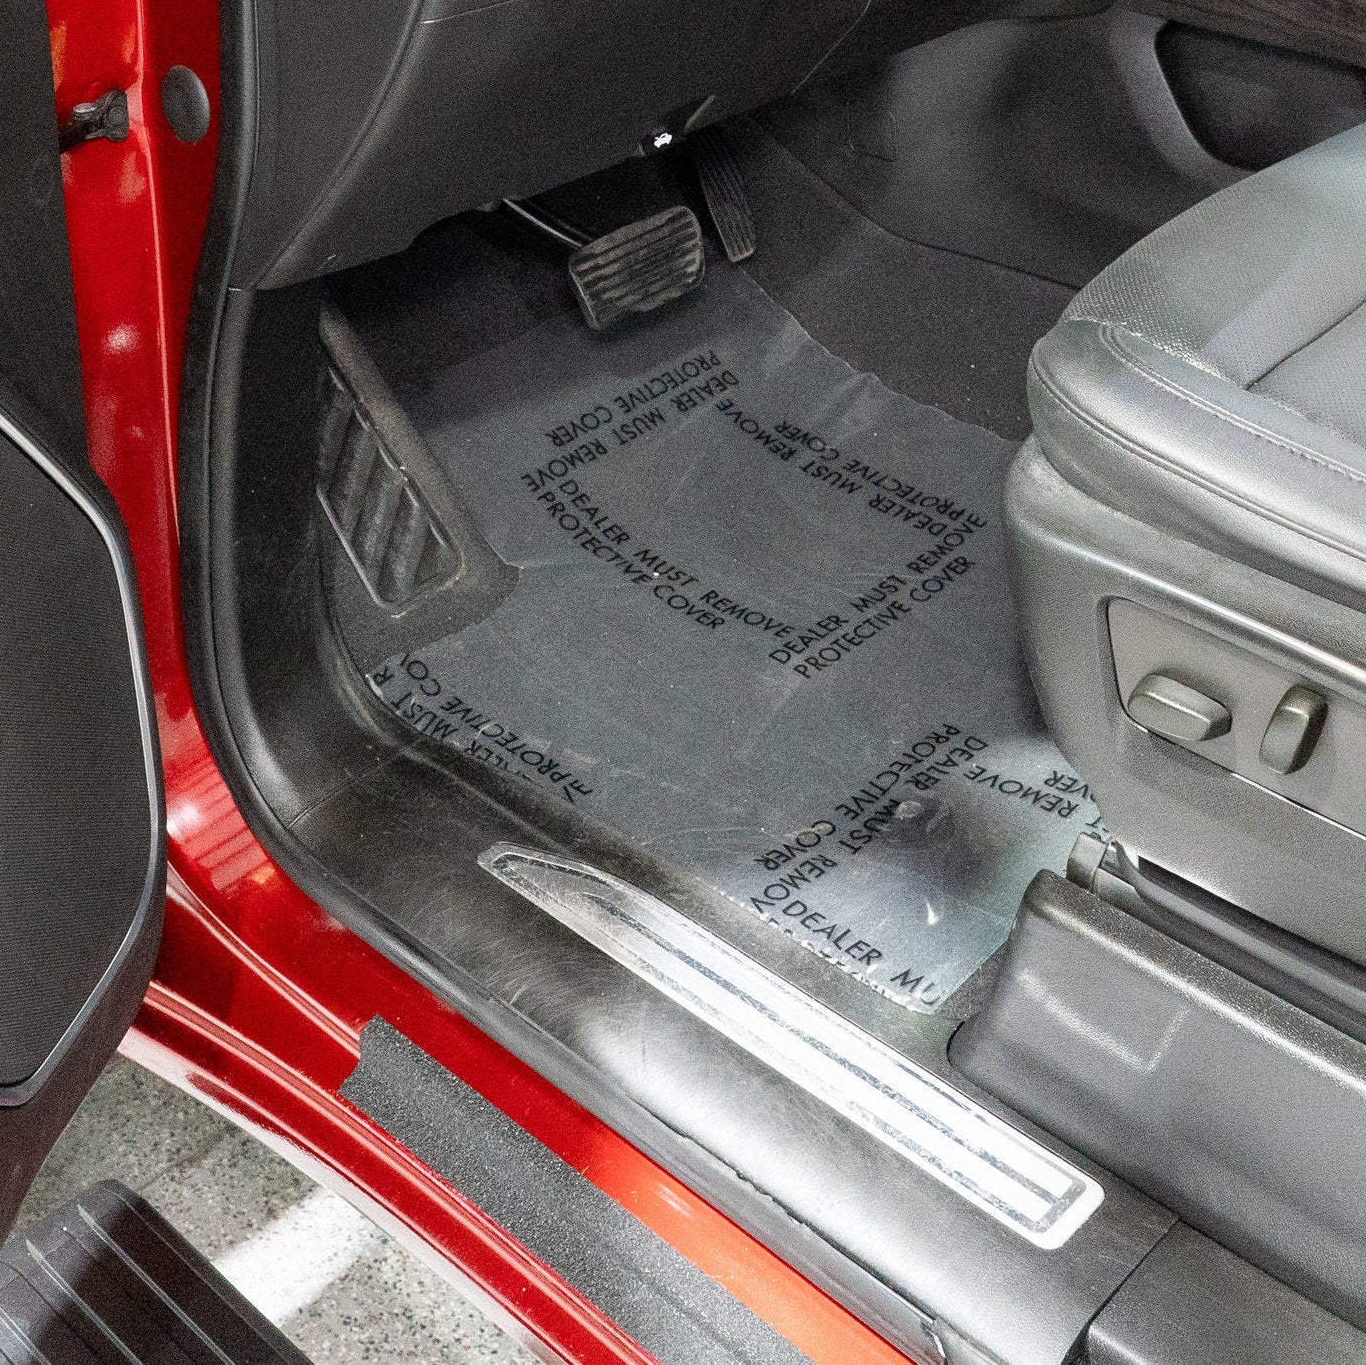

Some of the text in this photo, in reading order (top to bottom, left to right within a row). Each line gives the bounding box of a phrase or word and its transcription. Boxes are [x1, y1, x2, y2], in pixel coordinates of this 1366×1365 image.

[520, 370, 740, 492] DEALER MUST REMOVE
[546, 349, 722, 447] PROTECTIVE COVER
[715, 397, 948, 536] DEALER MUST REMOVE
[773, 420, 968, 521] PROTECTIVE COVER
[537, 491, 726, 631] PROTECTIVE COVER
[559, 479, 795, 638] DEALER MUST REMOVE
[768, 512, 987, 665] DEALER MUST REMOVE
[792, 555, 977, 679] PROTECTIVE COVER
[391, 691, 459, 743] MUST
[439, 696, 572, 784] PROTECTIVE
[904, 735, 989, 792] DEALER
[753, 723, 962, 871] PROTECTIVE COVER
[838, 798, 901, 855] MUST
[963, 765, 1080, 819] REMOVE
[782, 899, 883, 966] DEALER
